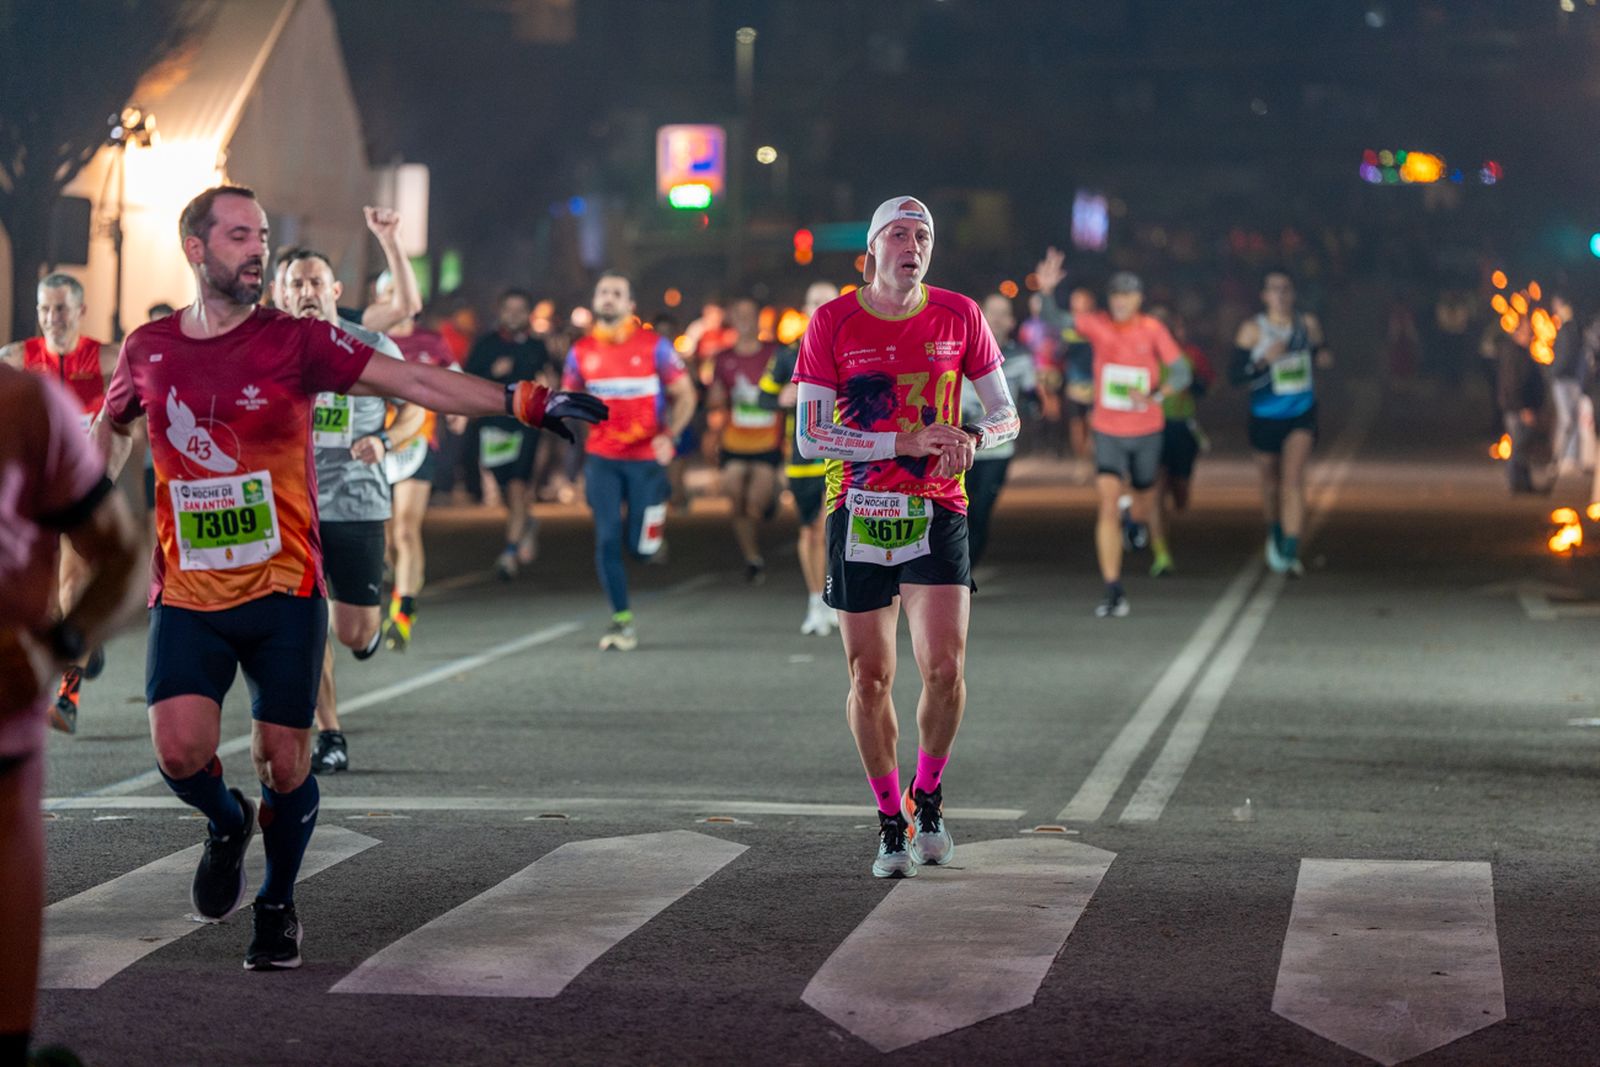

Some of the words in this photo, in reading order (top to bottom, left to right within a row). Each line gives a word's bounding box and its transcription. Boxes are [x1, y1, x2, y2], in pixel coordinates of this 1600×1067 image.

[896, 370, 957, 432] 30
[186, 435, 212, 461] 43
[191, 489, 219, 499] NOCHE
[221, 487, 233, 497] DE
[864, 498, 888, 507] NOCHE
[889, 498, 900, 507] DE
[183, 500, 201, 511] SAN
[202, 497, 235, 511] ANTÓN
[853, 507, 870, 517] SAN
[871, 506, 901, 517] ANTÓN
[191, 507, 257, 539] 7309
[863, 518, 914, 542] 3617
